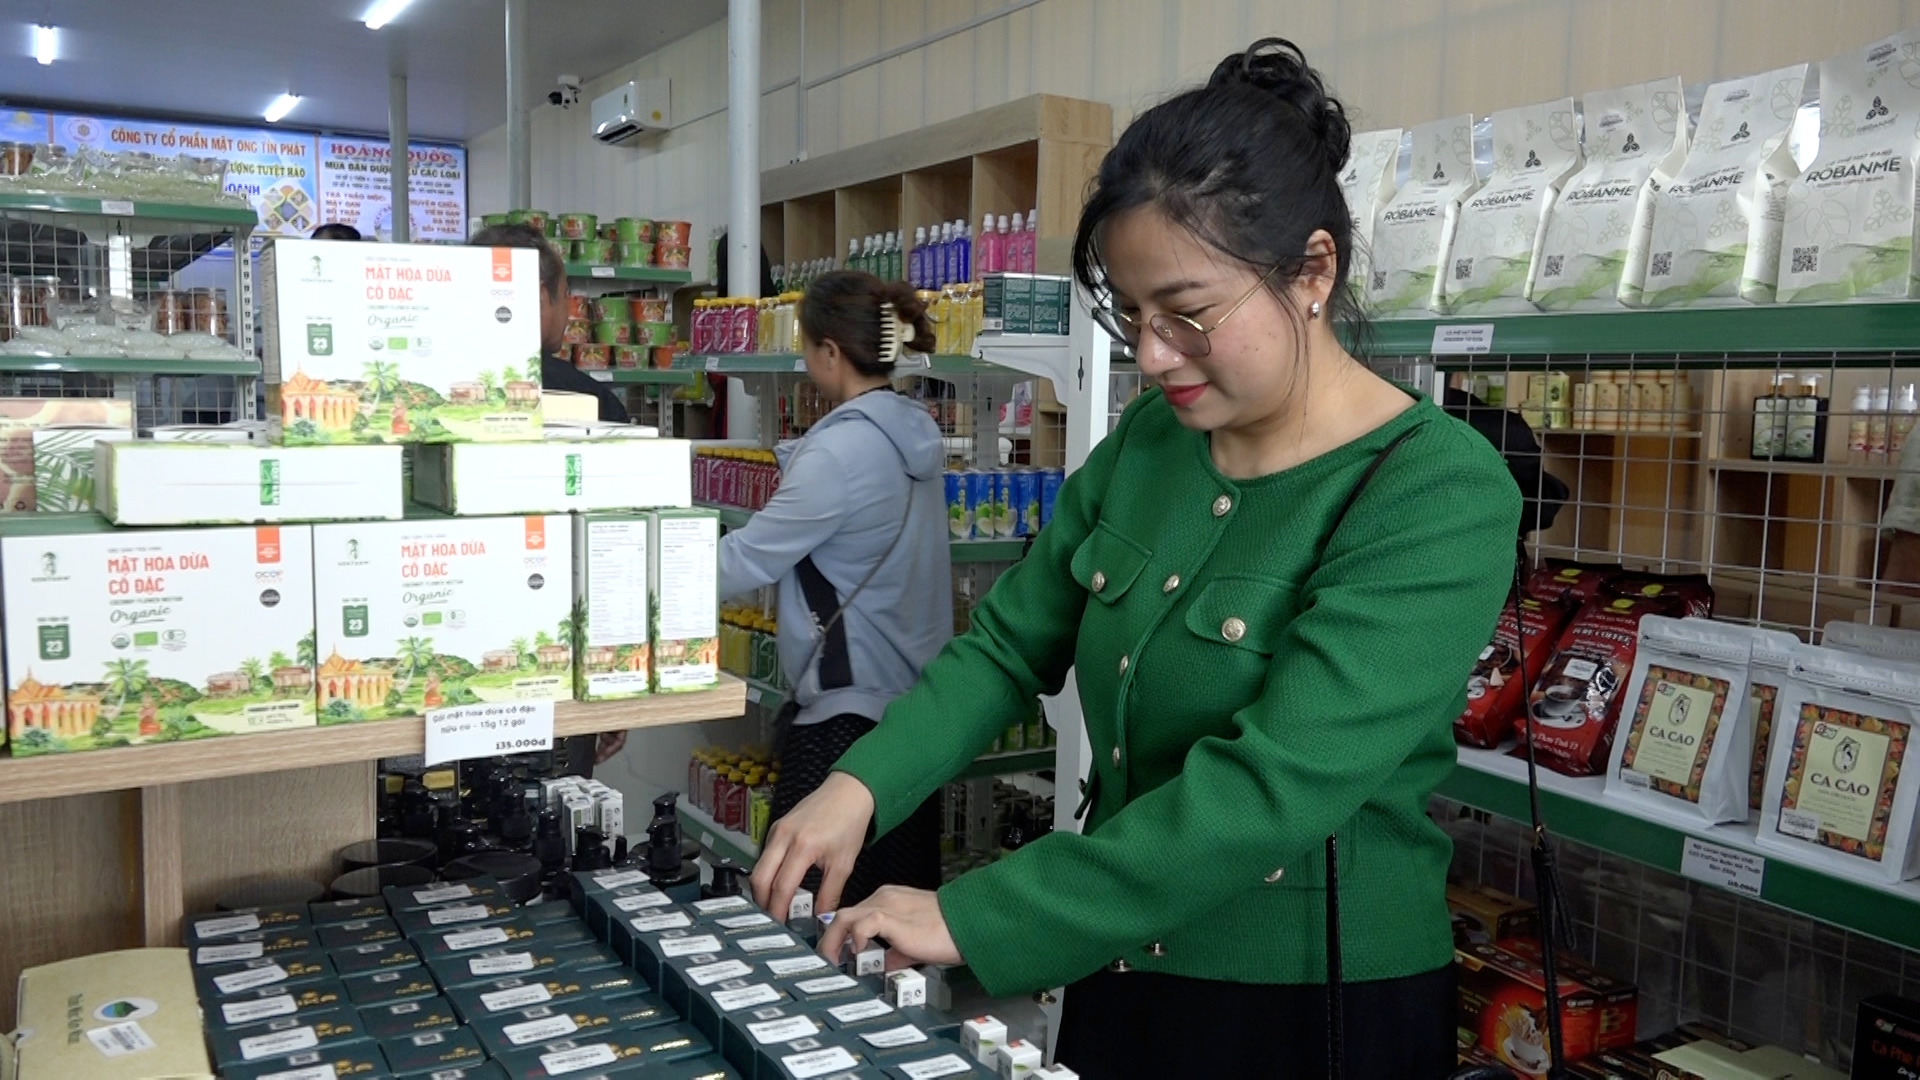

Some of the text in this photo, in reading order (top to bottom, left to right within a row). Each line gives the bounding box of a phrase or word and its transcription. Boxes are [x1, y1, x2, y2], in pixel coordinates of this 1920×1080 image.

[112, 127, 141, 144] CÔNG
[144, 132, 157, 144] TY
[179, 132, 208, 149] PHẦN
[212, 136, 233, 153] MẬT
[237, 141, 258, 152] ONG
[281, 141, 306, 157] PHÁT
[228, 160, 255, 175] ƯỢNG
[325, 162, 345, 170] MUA
[1805, 156, 1902, 184] ROBANME
[365, 264, 452, 283] MẬT HOA DỪA
[368, 314, 420, 329] Organic
[401, 539, 486, 560] MẬT HOA DỪA
[107, 552, 209, 575] MẬT HOA DỪA
[135, 576, 165, 595] ĐẶC
[403, 588, 454, 604] Organic
[110, 606, 171, 626] Organic
[349, 619, 363, 630] 23
[499, 718, 508, 726] 12
[1649, 726, 1695, 746] CA CAO
[1811, 772, 1834, 787] CA
[1835, 778, 1870, 797] CAO
